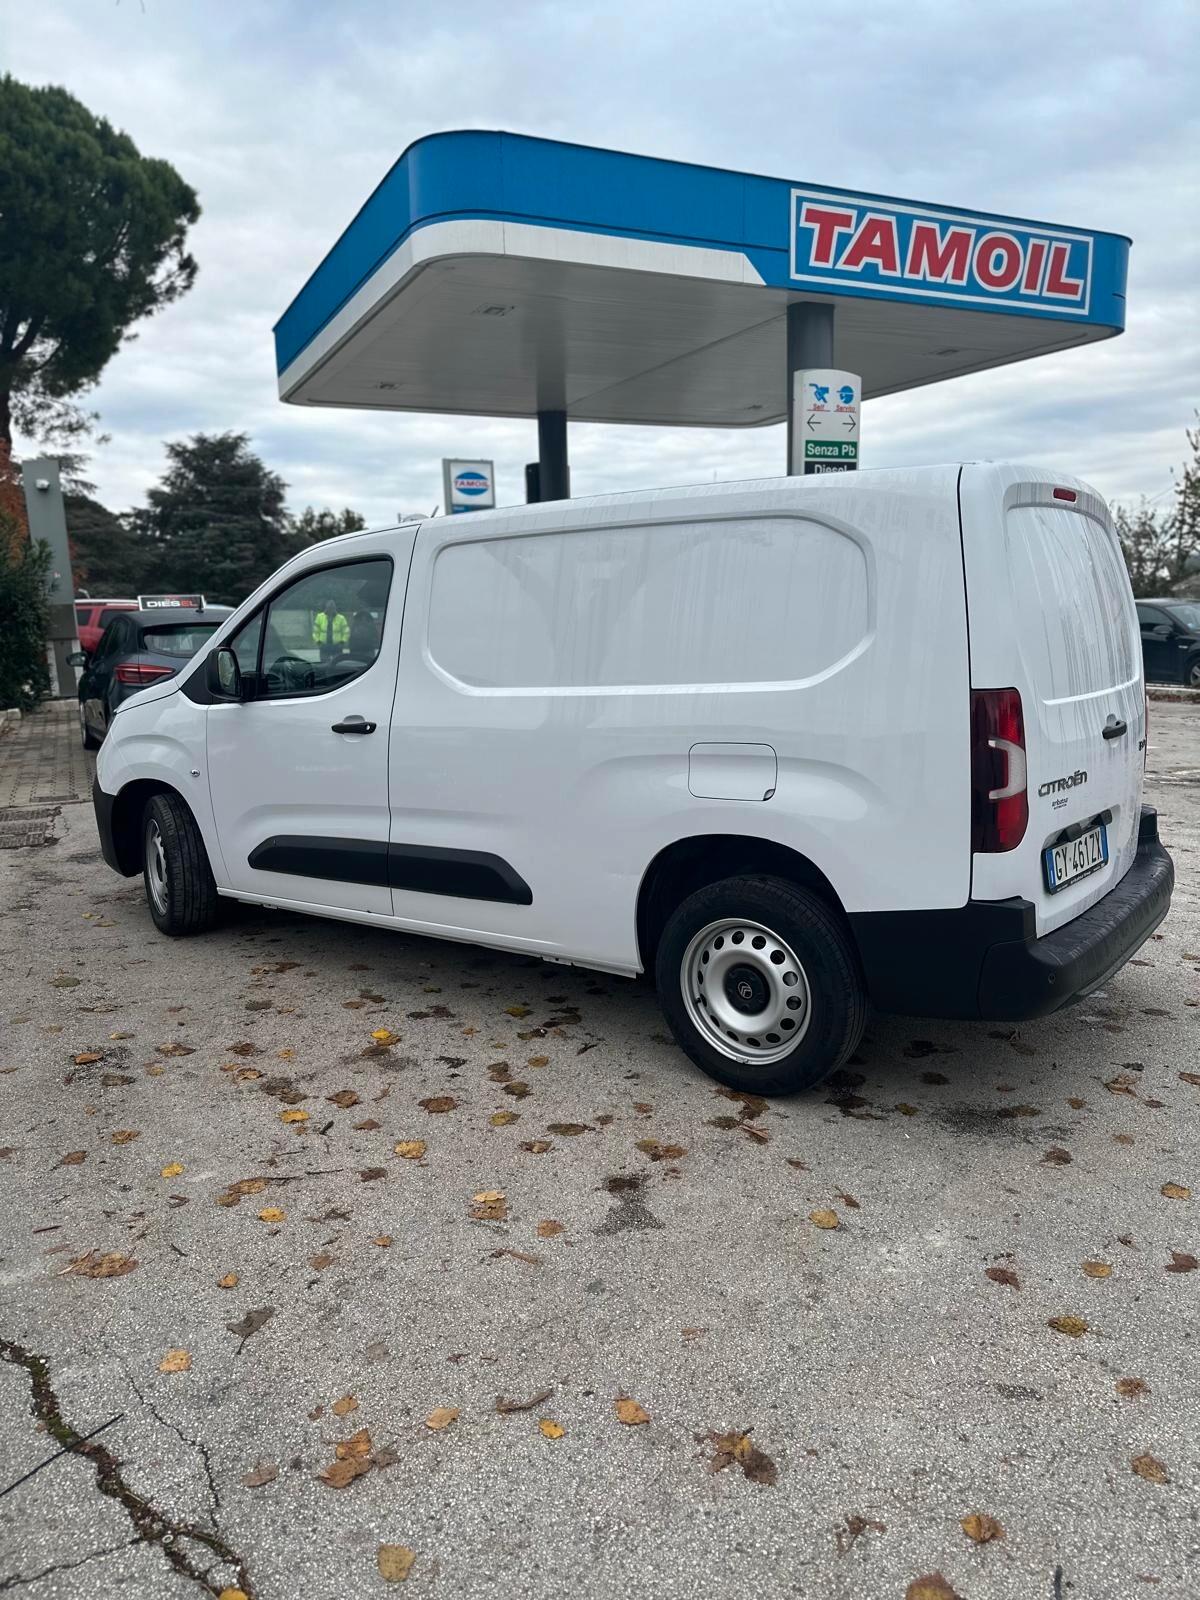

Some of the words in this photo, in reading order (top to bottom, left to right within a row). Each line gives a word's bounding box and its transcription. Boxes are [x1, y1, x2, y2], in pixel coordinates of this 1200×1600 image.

[801, 202, 1084, 300] TAMOIL
[807, 443, 839, 456] Senza
[841, 444, 856, 457] Pb
[454, 480, 490, 488] TAMOIL
[146, 600, 199, 608] DIESEL
[1055, 846, 1068, 881] GY
